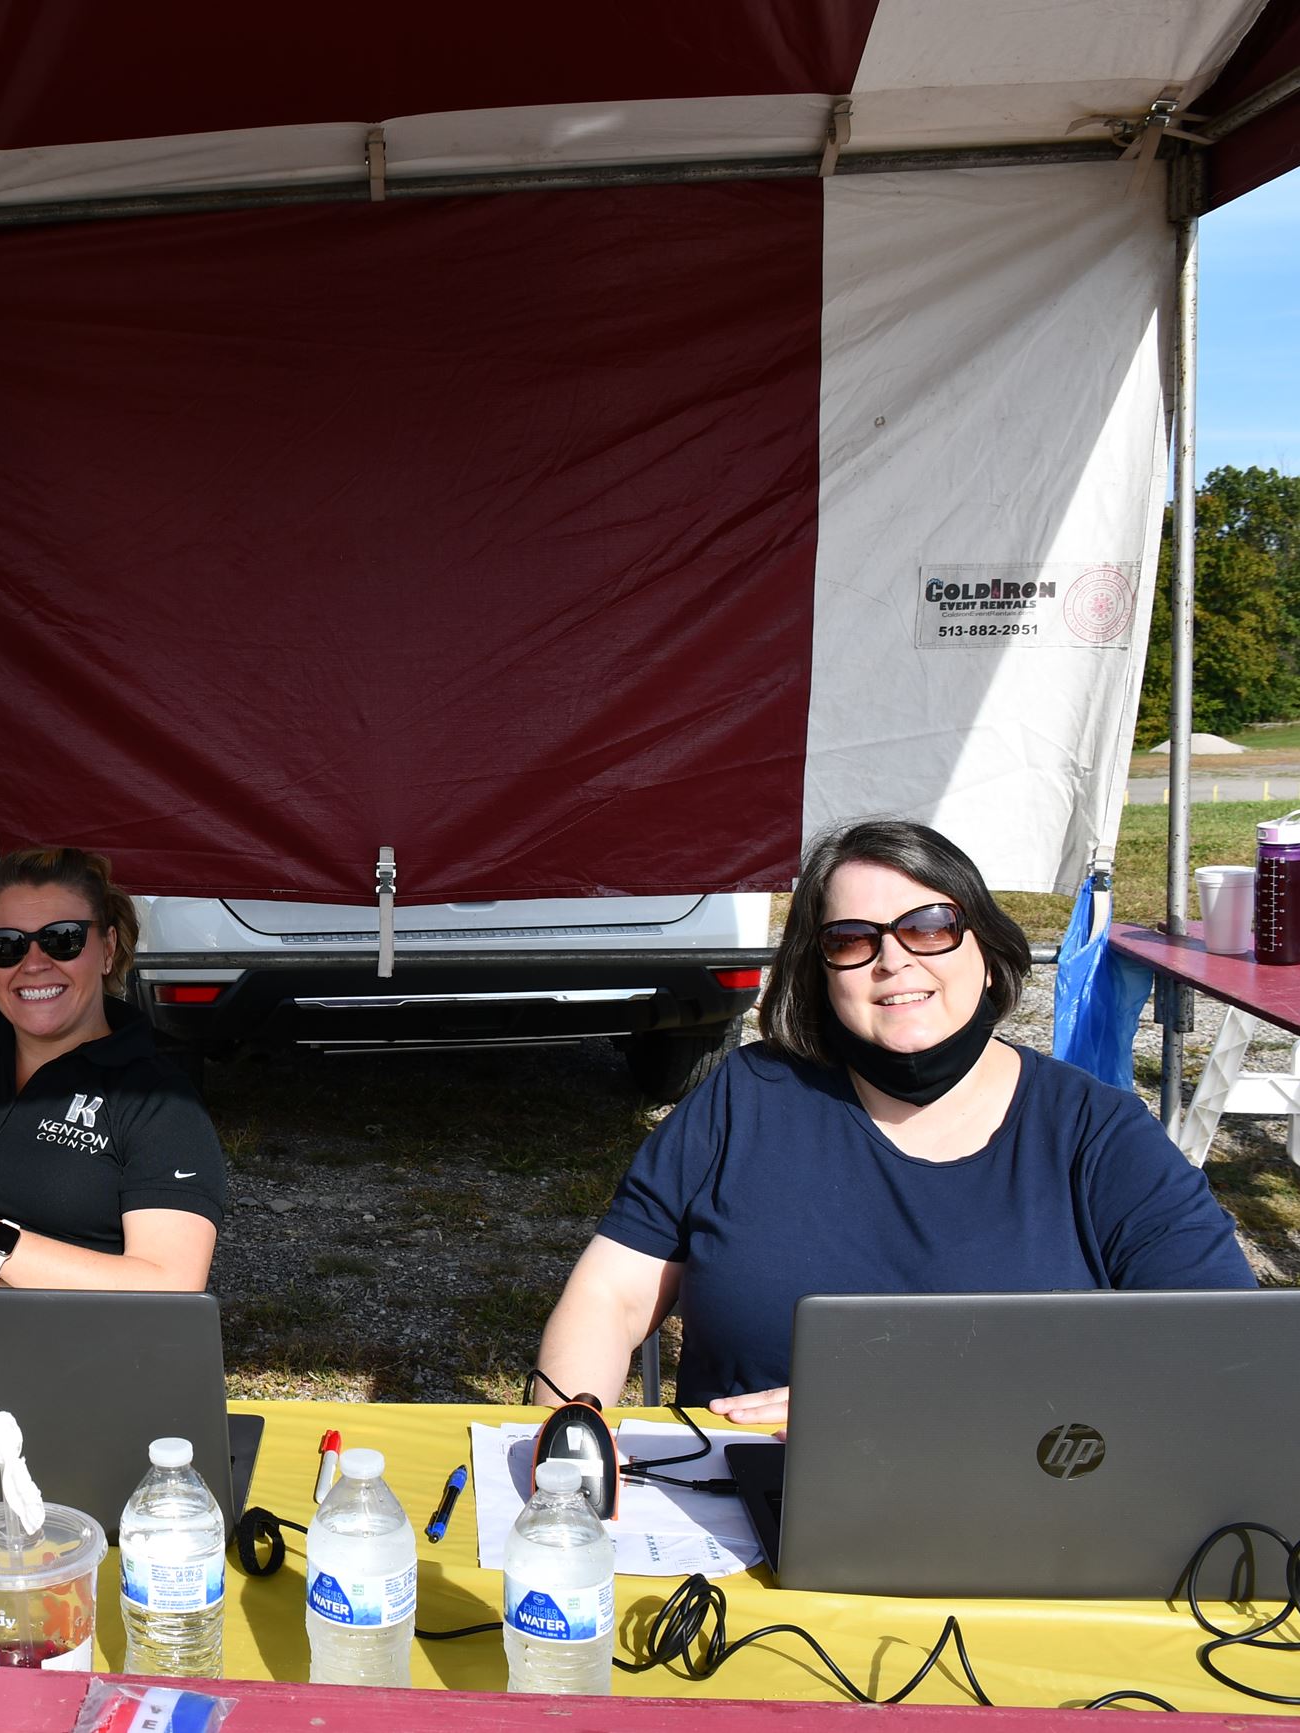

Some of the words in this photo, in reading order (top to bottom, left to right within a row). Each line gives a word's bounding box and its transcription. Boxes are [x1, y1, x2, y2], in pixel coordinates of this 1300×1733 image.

[940, 601, 977, 610] EVENT
[980, 600, 1037, 609] RENTALS
[938, 624, 1038, 637] 513-882-2951
[36, 1132, 98, 1155] COUNTY
[37, 1118, 110, 1150] KENTON
[1043, 1424, 1099, 1480] hp
[312, 1590, 350, 1616] WATER
[523, 1602, 558, 1615] PURIFIED
[519, 1611, 566, 1632] WATER
